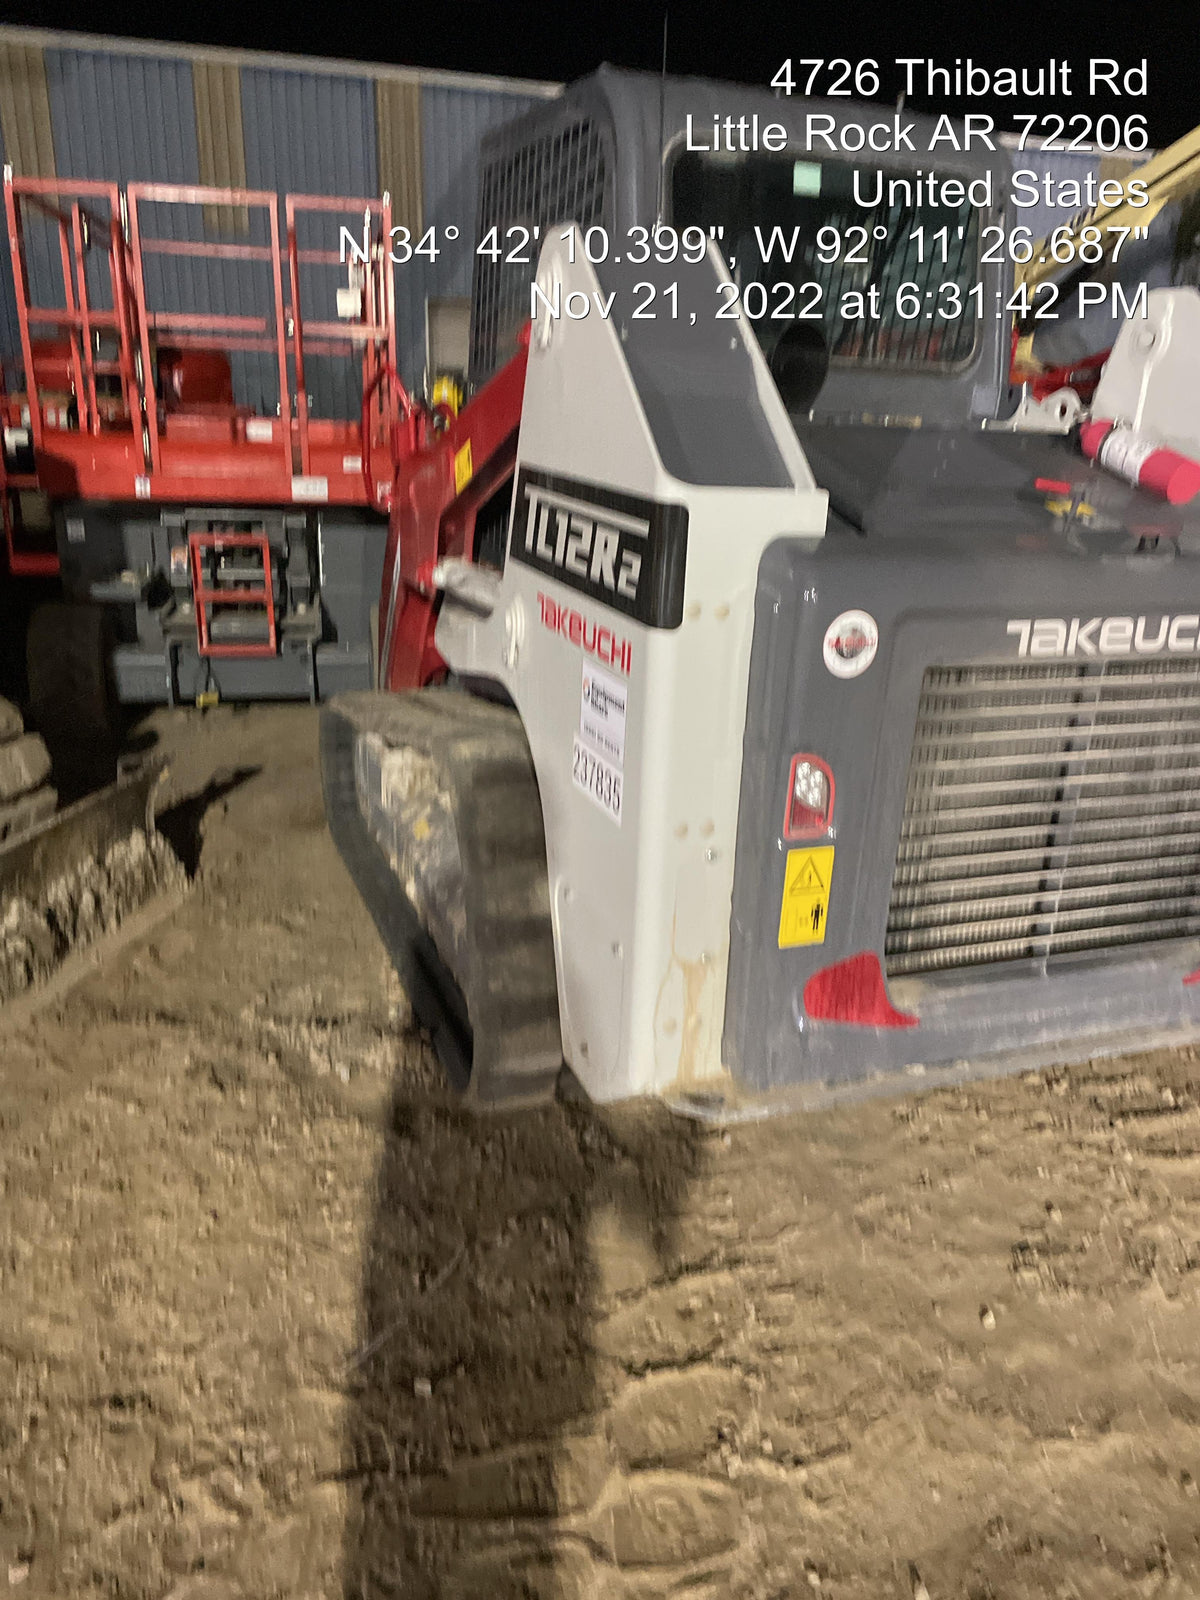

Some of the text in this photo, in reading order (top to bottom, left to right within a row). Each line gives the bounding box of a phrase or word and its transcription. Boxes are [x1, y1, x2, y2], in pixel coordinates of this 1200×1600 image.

[537, 591, 632, 676] TAKEUCHI
[1007, 614, 1200, 657] TAKEUC
[573, 744, 621, 816] 237835
